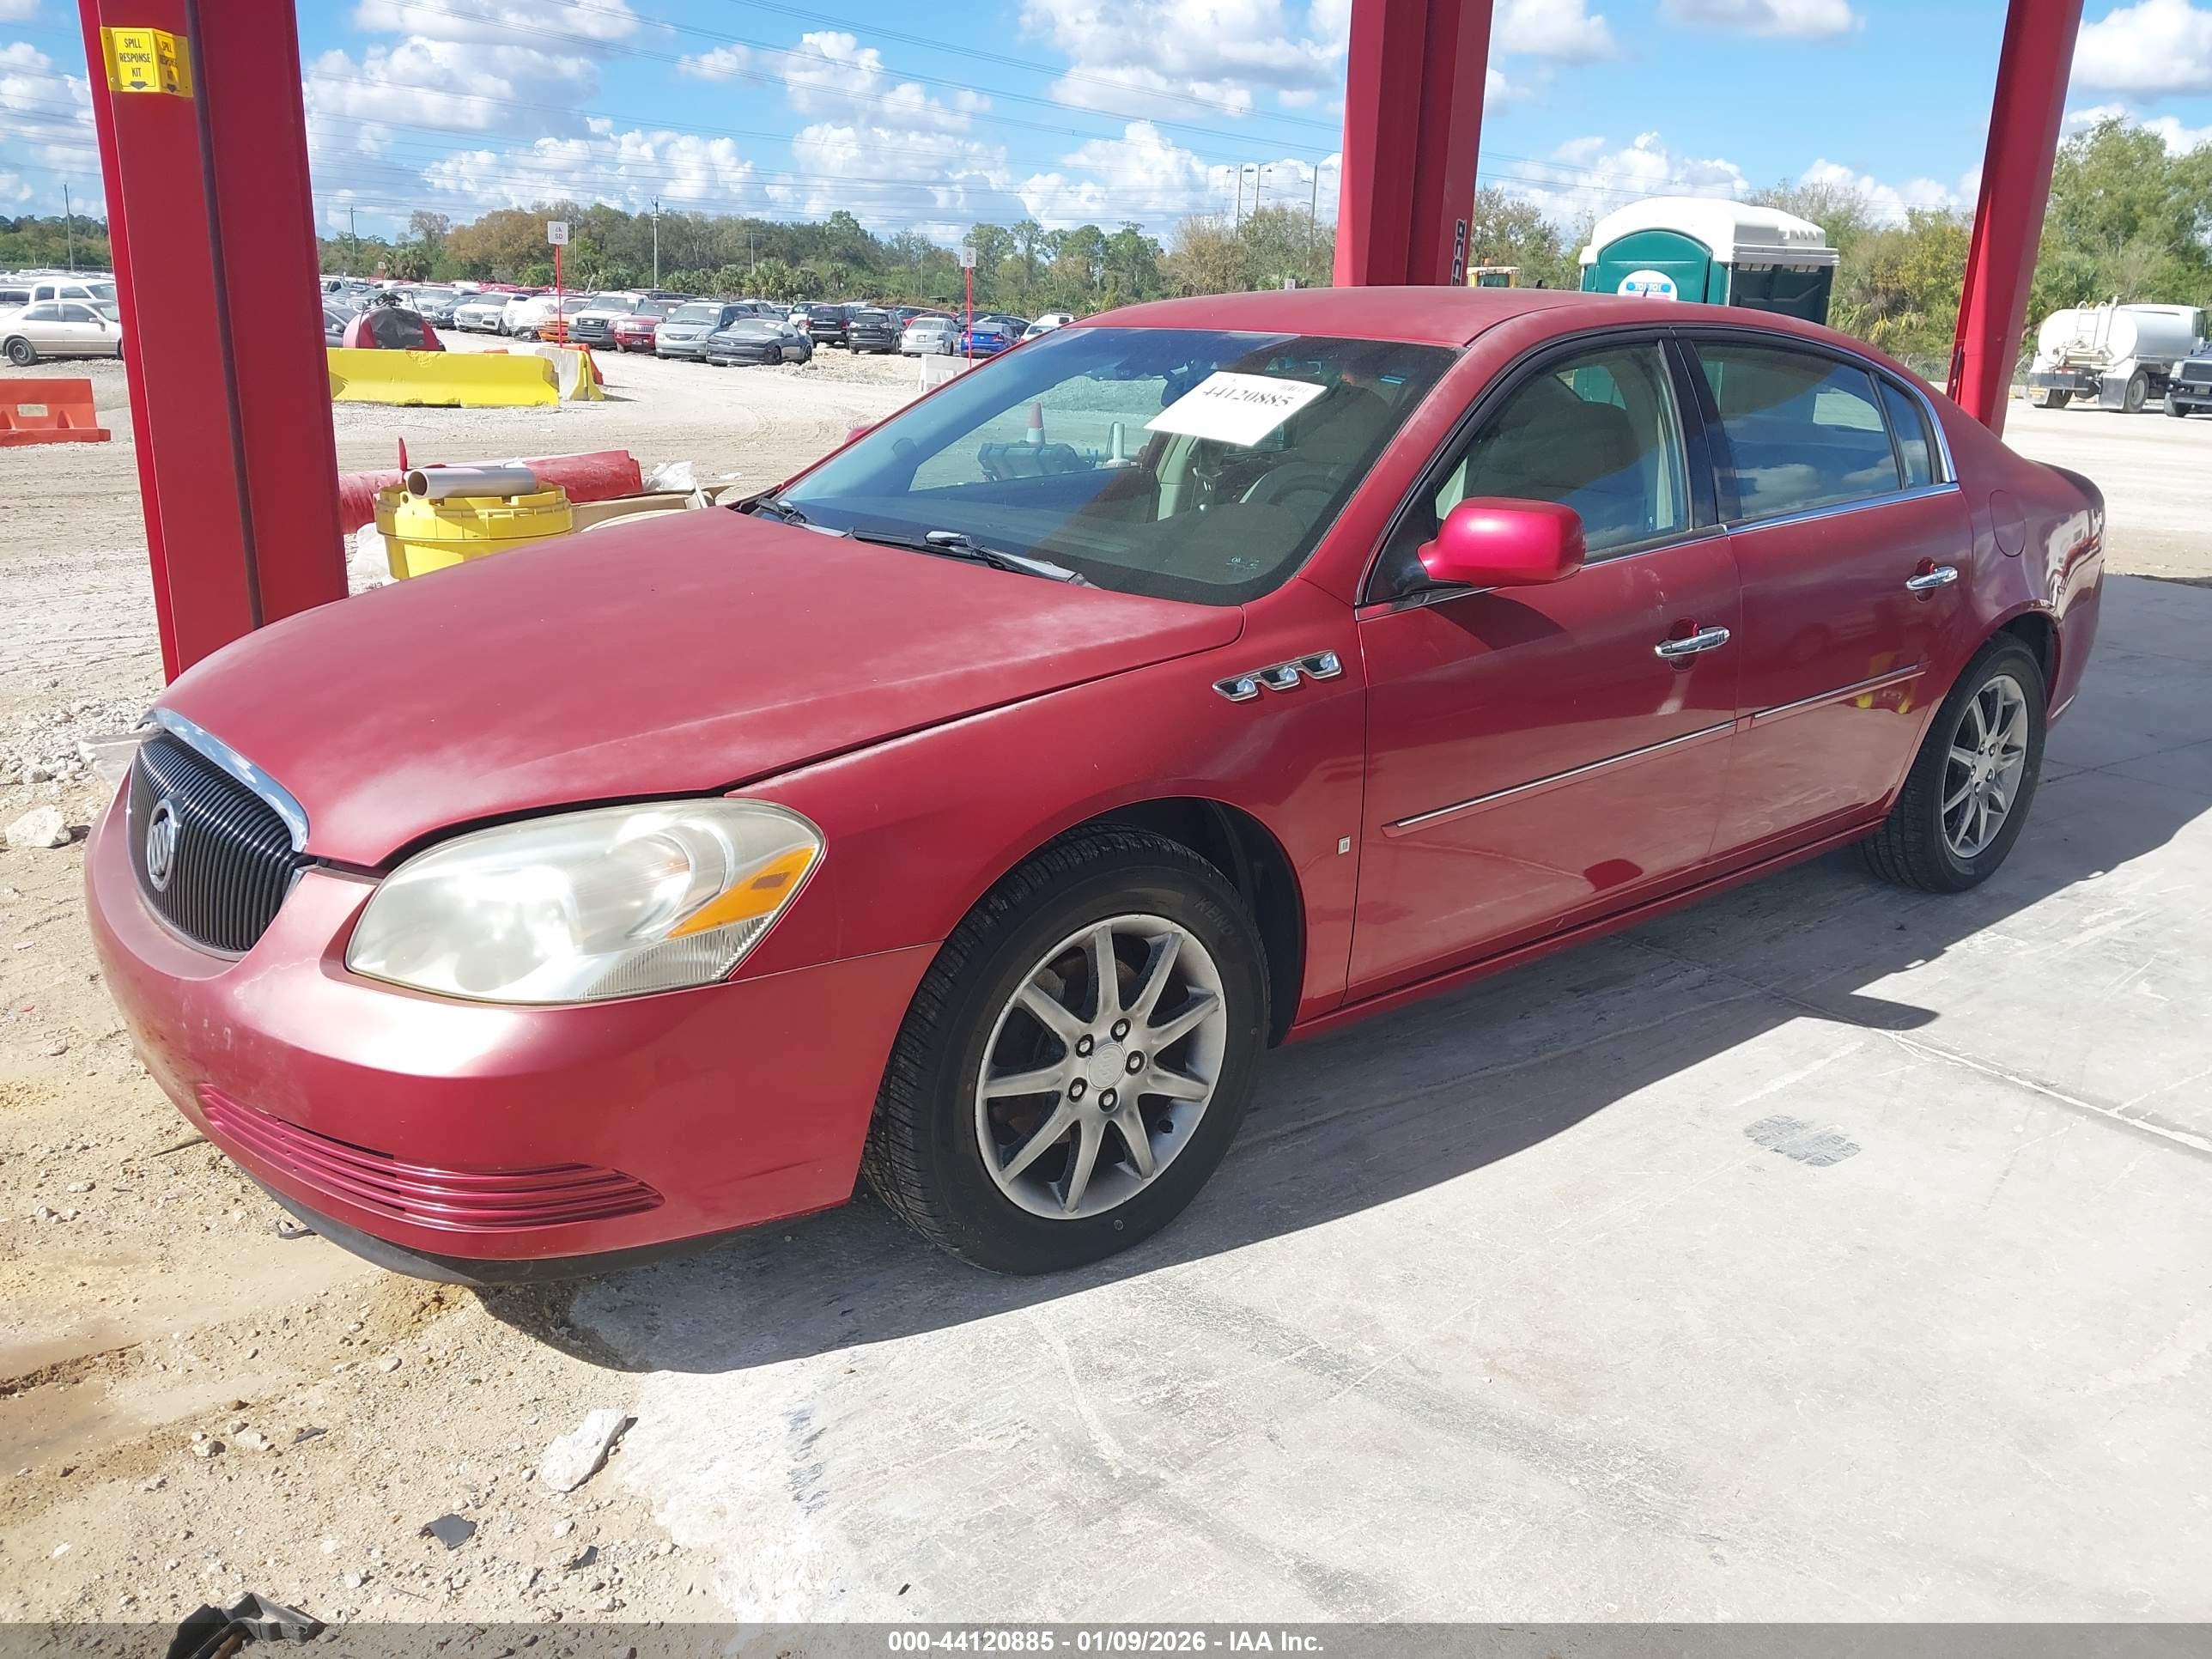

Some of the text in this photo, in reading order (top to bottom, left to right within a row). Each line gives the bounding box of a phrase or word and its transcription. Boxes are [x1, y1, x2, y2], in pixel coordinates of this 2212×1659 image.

[124, 38, 142, 48] SPILL
[118, 52, 151, 63] RESPONSE
[131, 68, 142, 77] KIT
[1203, 386, 1295, 407] 44120885
